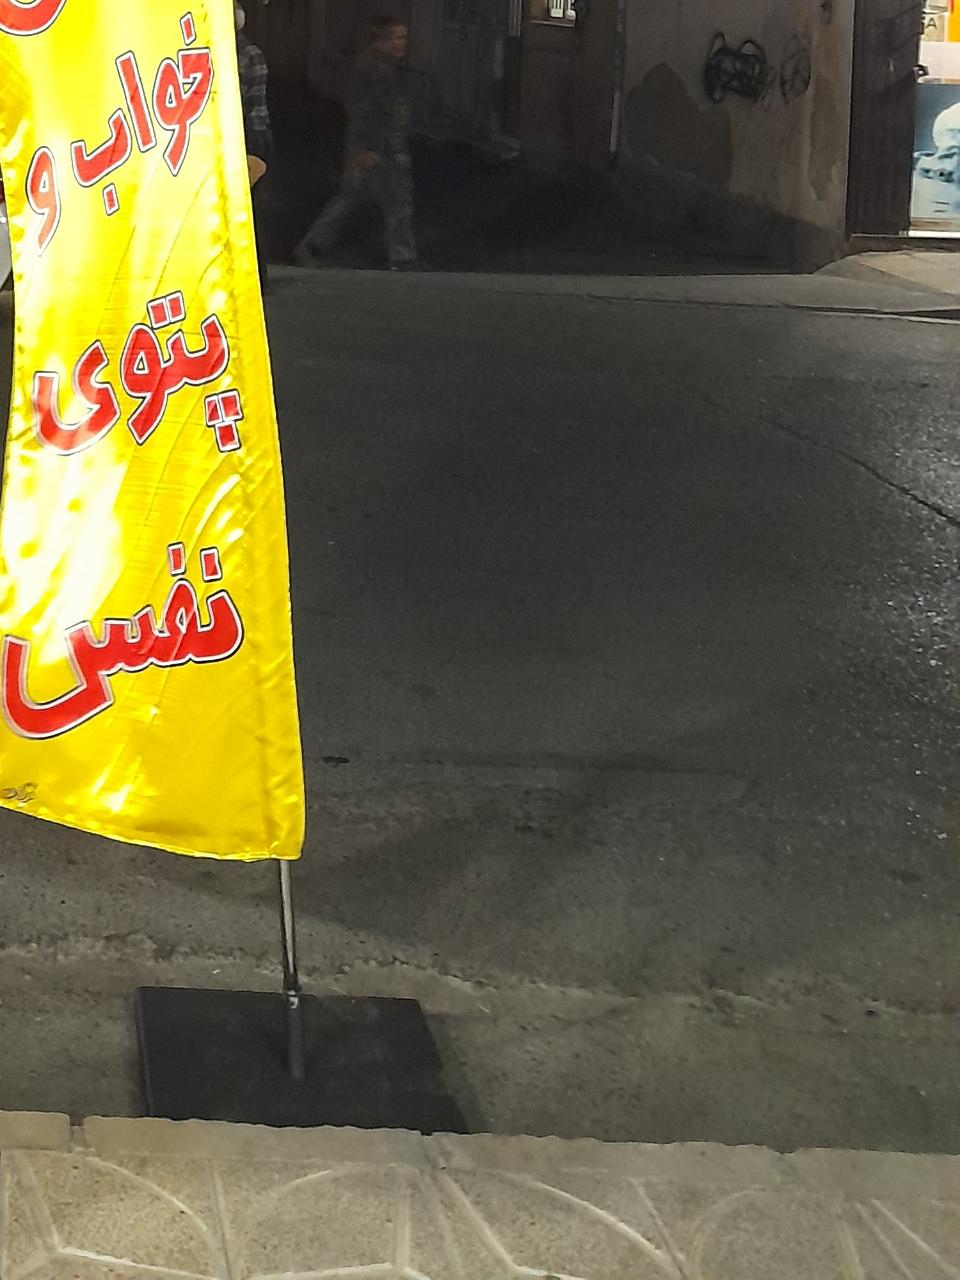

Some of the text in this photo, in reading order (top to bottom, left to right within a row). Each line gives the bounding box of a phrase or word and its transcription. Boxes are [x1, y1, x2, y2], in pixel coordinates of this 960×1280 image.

[26, 13, 213, 256] خواب و
[33, 290, 242, 457] پتوی
[1, 543, 244, 740] نفس
